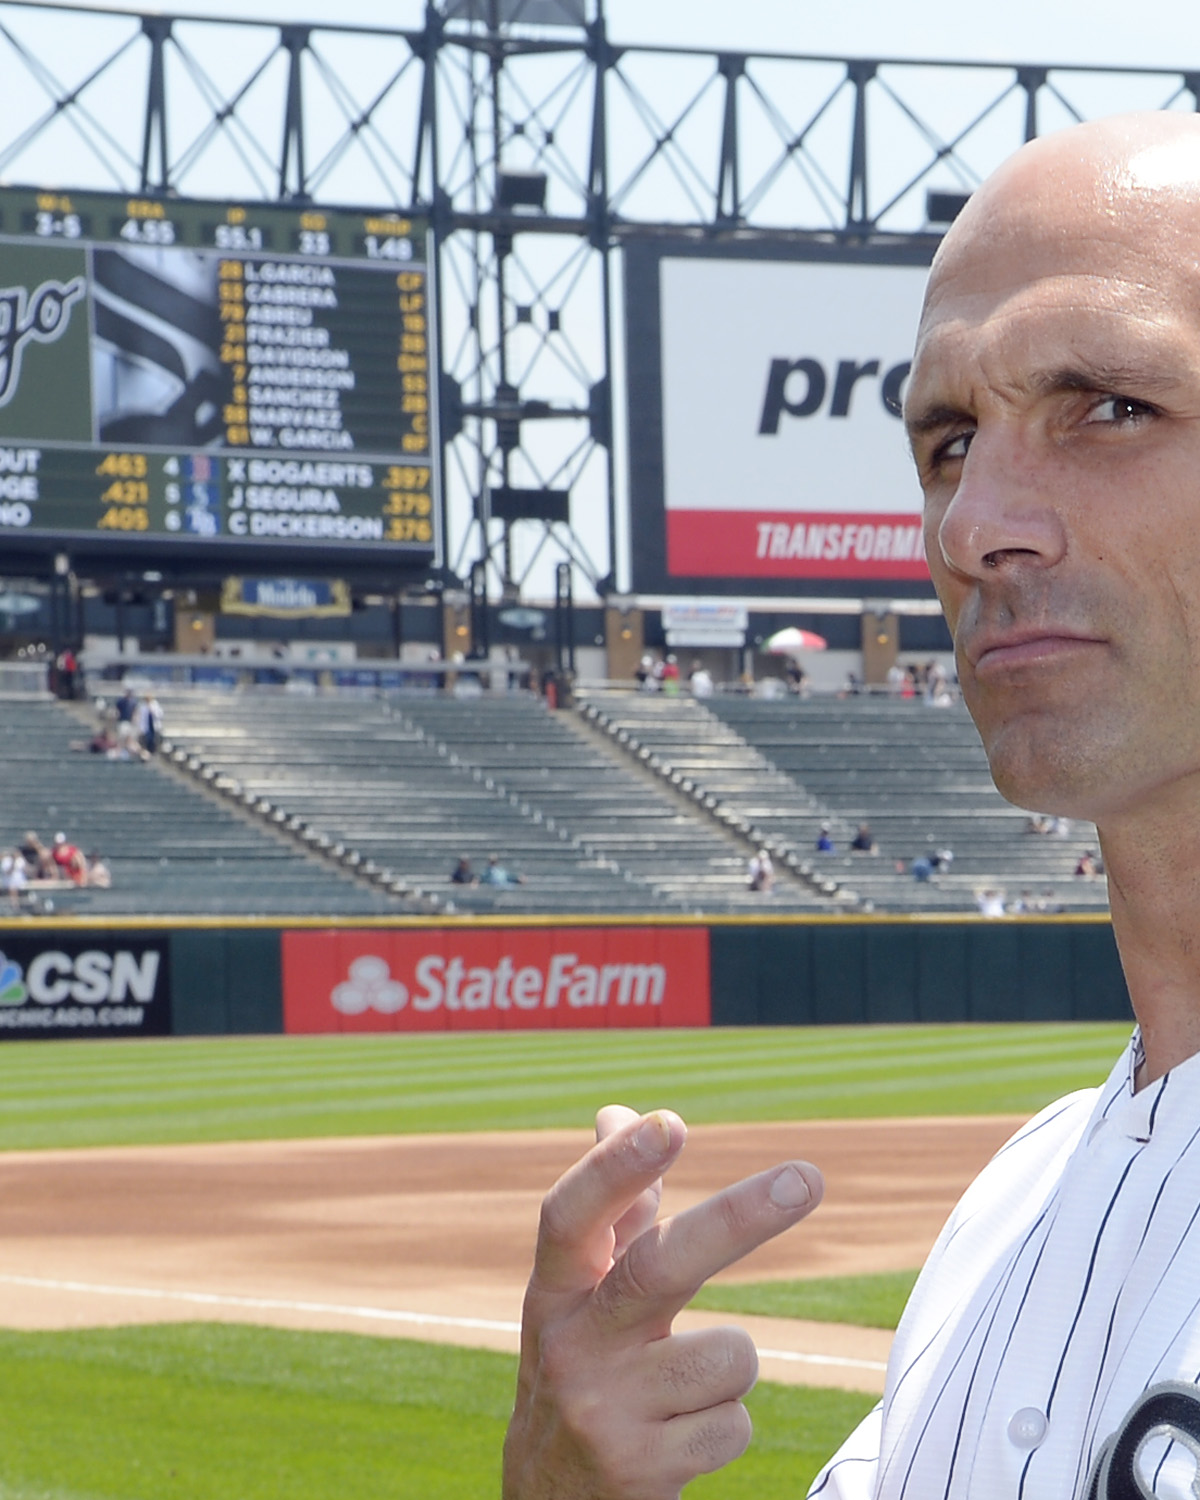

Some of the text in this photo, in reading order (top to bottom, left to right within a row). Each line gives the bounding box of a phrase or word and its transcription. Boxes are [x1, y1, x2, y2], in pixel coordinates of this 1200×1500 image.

[245, 283, 338, 309] CABRERA
[246, 303, 313, 327] ABREU
[246, 324, 330, 348] FRAZIER
[247, 344, 349, 369] DAVIDSON
[248, 364, 355, 390] ANDERSON
[249, 384, 340, 409] SANCHEZ
[249, 404, 342, 430] NARVAEZ
[279, 426, 355, 450] GARCIA
[163, 456, 180, 477] 4
[227, 457, 246, 483] X
[248, 458, 374, 489] BOGAERTS
[0, 475, 39, 501] GE
[227, 484, 244, 510] J
[245, 485, 341, 514] SEGURA
[228, 510, 249, 536] C
[249, 511, 384, 541] DICKERSON
[26, 949, 160, 1005] CSN
